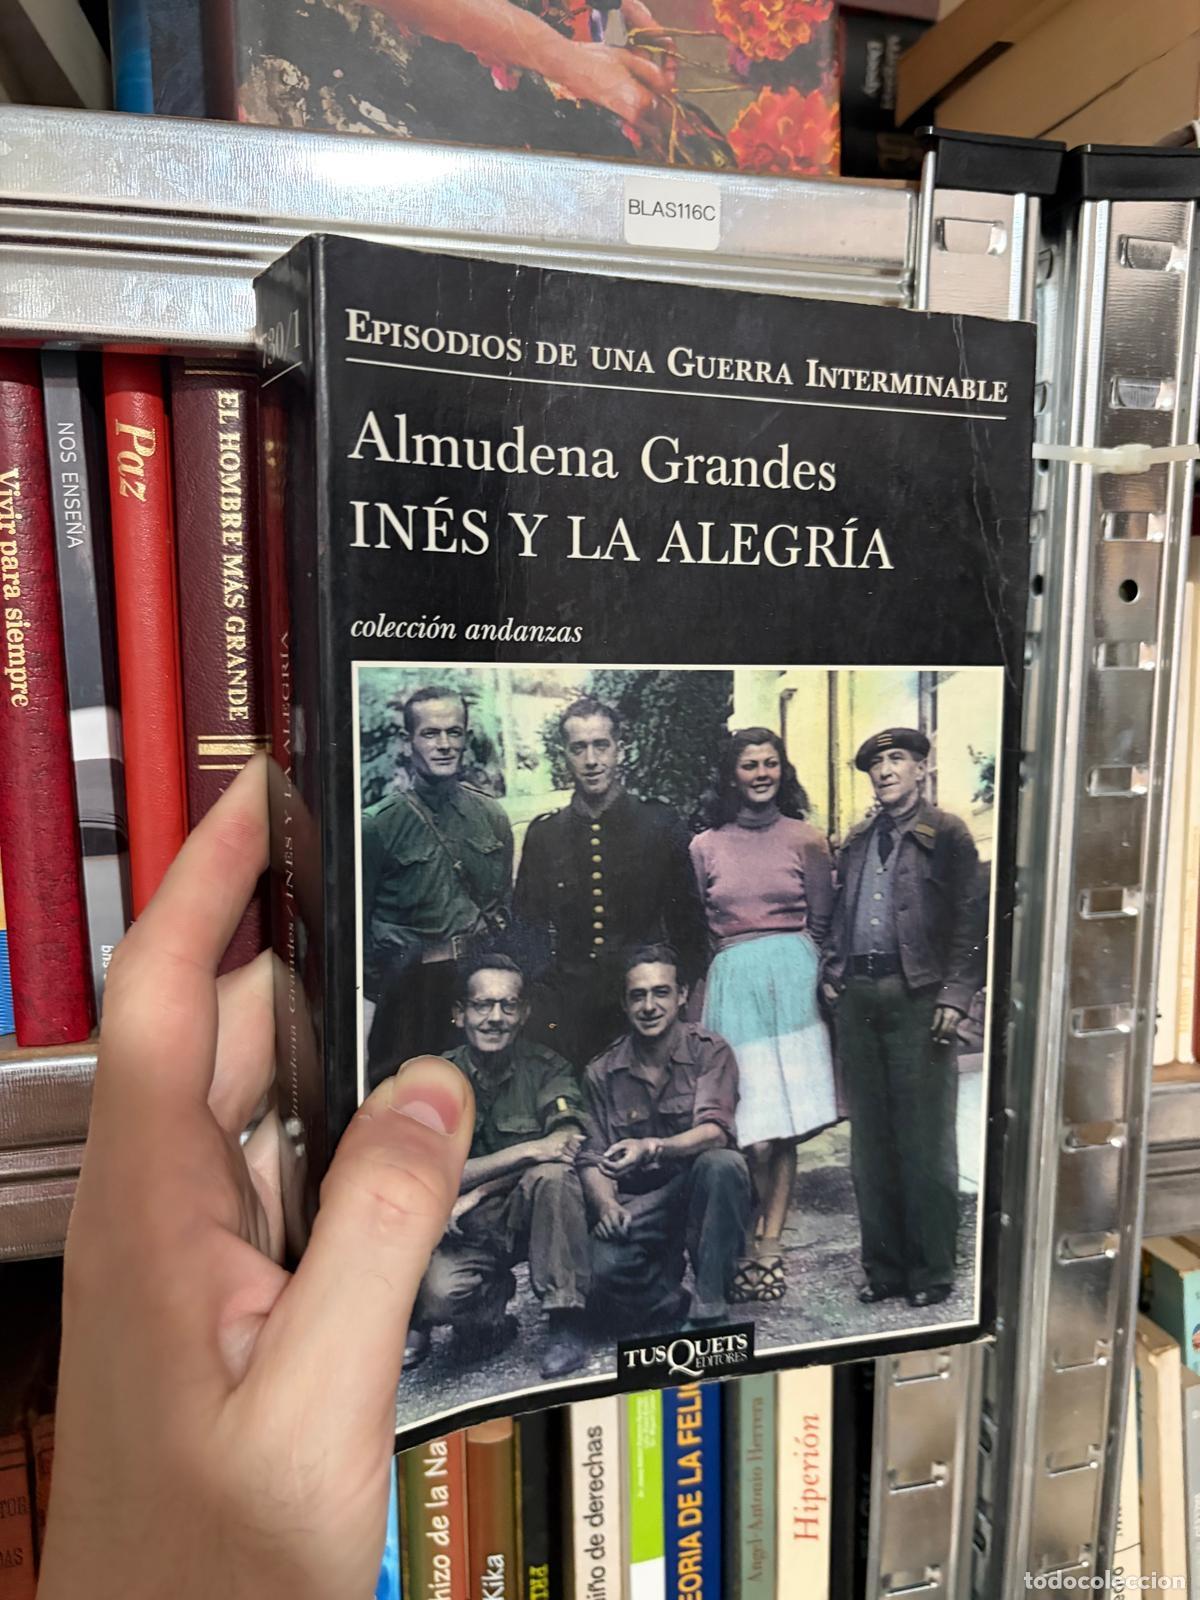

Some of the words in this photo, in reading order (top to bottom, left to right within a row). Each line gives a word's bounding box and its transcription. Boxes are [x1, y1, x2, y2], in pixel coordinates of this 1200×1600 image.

[628, 198, 716, 222] BLAS116C
[345, 308, 523, 362] EPISODIOS
[535, 341, 578, 367] DE
[590, 346, 656, 374] UNA
[667, 347, 794, 385] GUERRA
[805, 358, 1008, 403] INTERMINABLE
[218, 389, 239, 424] EL
[57, 422, 78, 463] NOS
[115, 419, 156, 502] Paz
[347, 410, 619, 479] Almudena
[641, 436, 837, 492] Grandes
[0, 467, 23, 536] Vivir
[61, 472, 87, 549] ENSEÑA
[219, 430, 243, 546] HOMBRE
[349, 496, 489, 555] INÉS
[508, 512, 549, 557] Y
[566, 515, 641, 562] LA
[656, 517, 895, 569] ALEGRÍA
[0, 541, 22, 600] para
[222, 553, 248, 609] MÁS
[350, 613, 457, 640] colección
[465, 617, 583, 643] andanzas
[5, 607, 31, 708] siempre
[224, 616, 249, 722] GRANDE
[624, 1333, 749, 1377] TUSQUETS
[695, 1351, 749, 1369] EDITORES
[746, 1397, 764, 1462] Herrera
[582, 1425, 605, 1528] derechas
[677, 1449, 703, 1486] LA
[793, 1413, 828, 1541] Hiperión
[425, 1484, 449, 1509] la
[677, 1490, 703, 1527] DE
[425, 1515, 450, 1546] de
[584, 1535, 606, 1561] de
[481, 1553, 505, 1600] Kika
